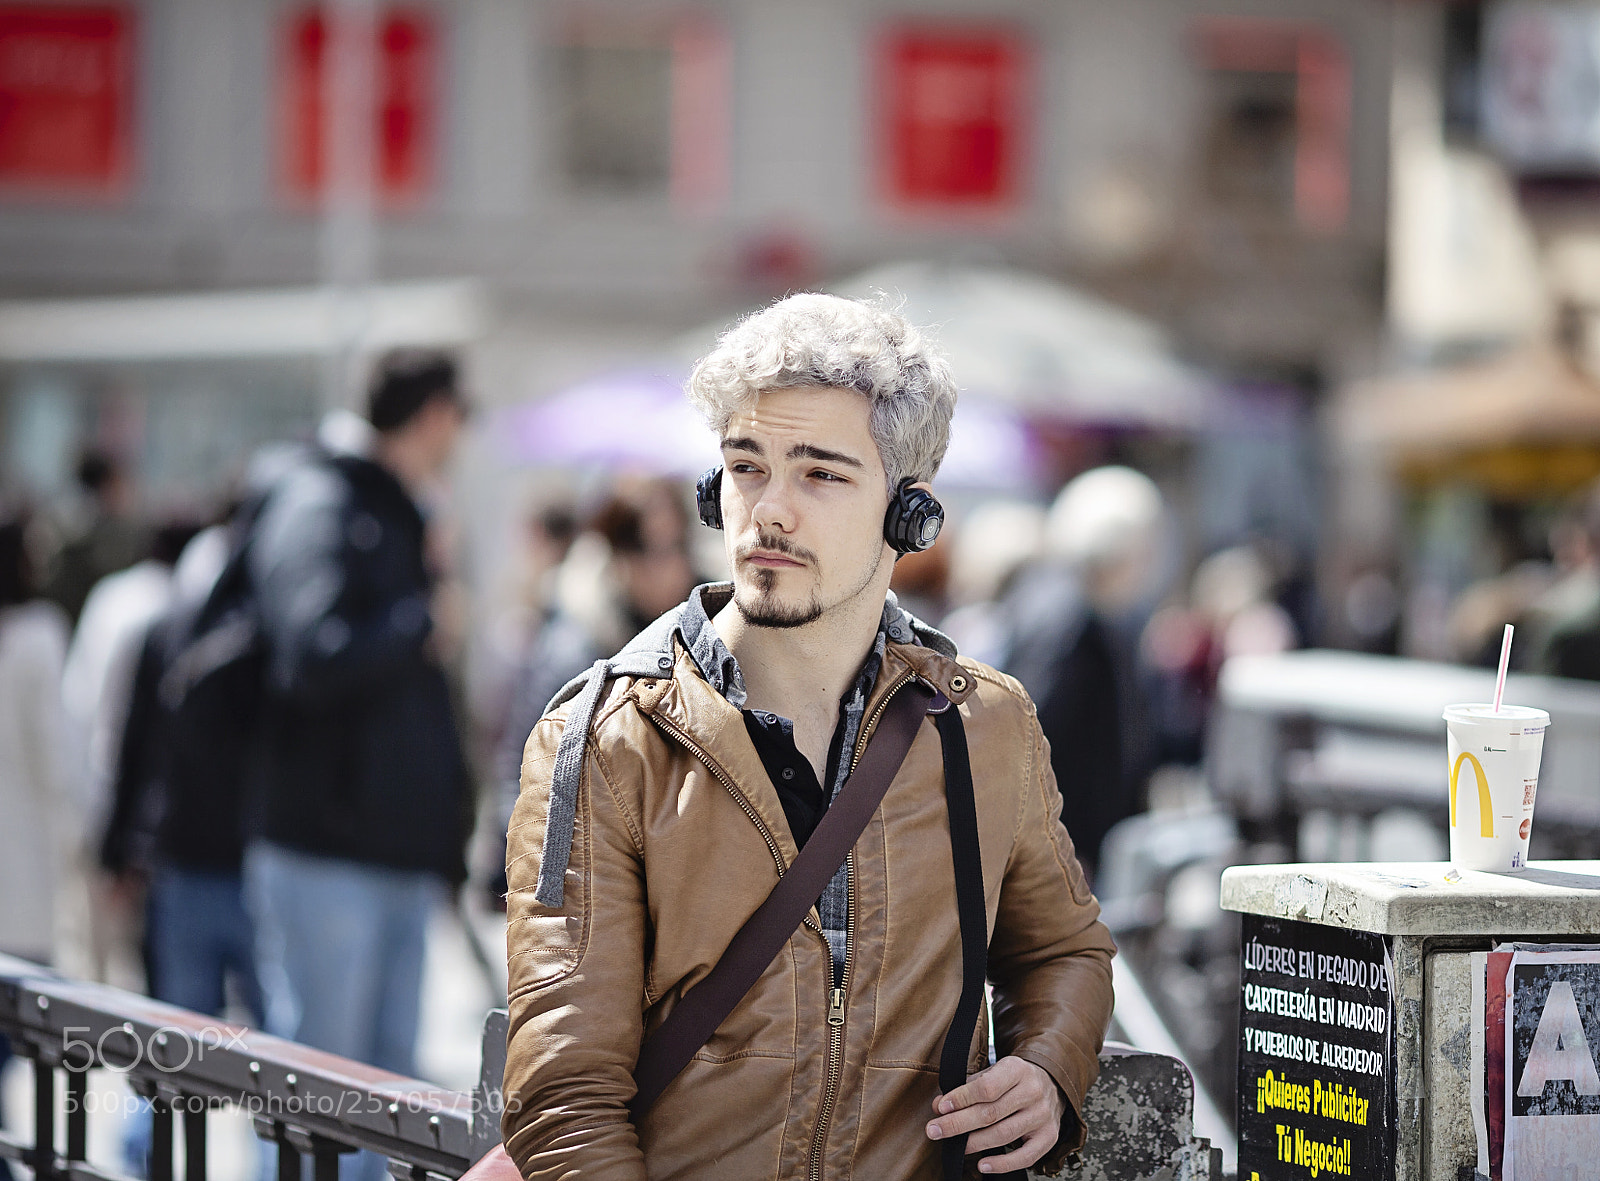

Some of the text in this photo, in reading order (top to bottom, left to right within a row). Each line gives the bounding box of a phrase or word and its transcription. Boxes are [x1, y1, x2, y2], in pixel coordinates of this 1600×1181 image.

[1245, 936, 1387, 992] LÍDERES EN PEGADO DE
[1245, 983, 1386, 1034] CARTELERÍA EN MADRID
[1245, 1027, 1383, 1077] Y PUEBLOS DE ALREDEDOR
[1517, 981, 1600, 1097] A
[1313, 1079, 1369, 1126] Publicitar
[1276, 1124, 1351, 1178] Tú Negocio!!
